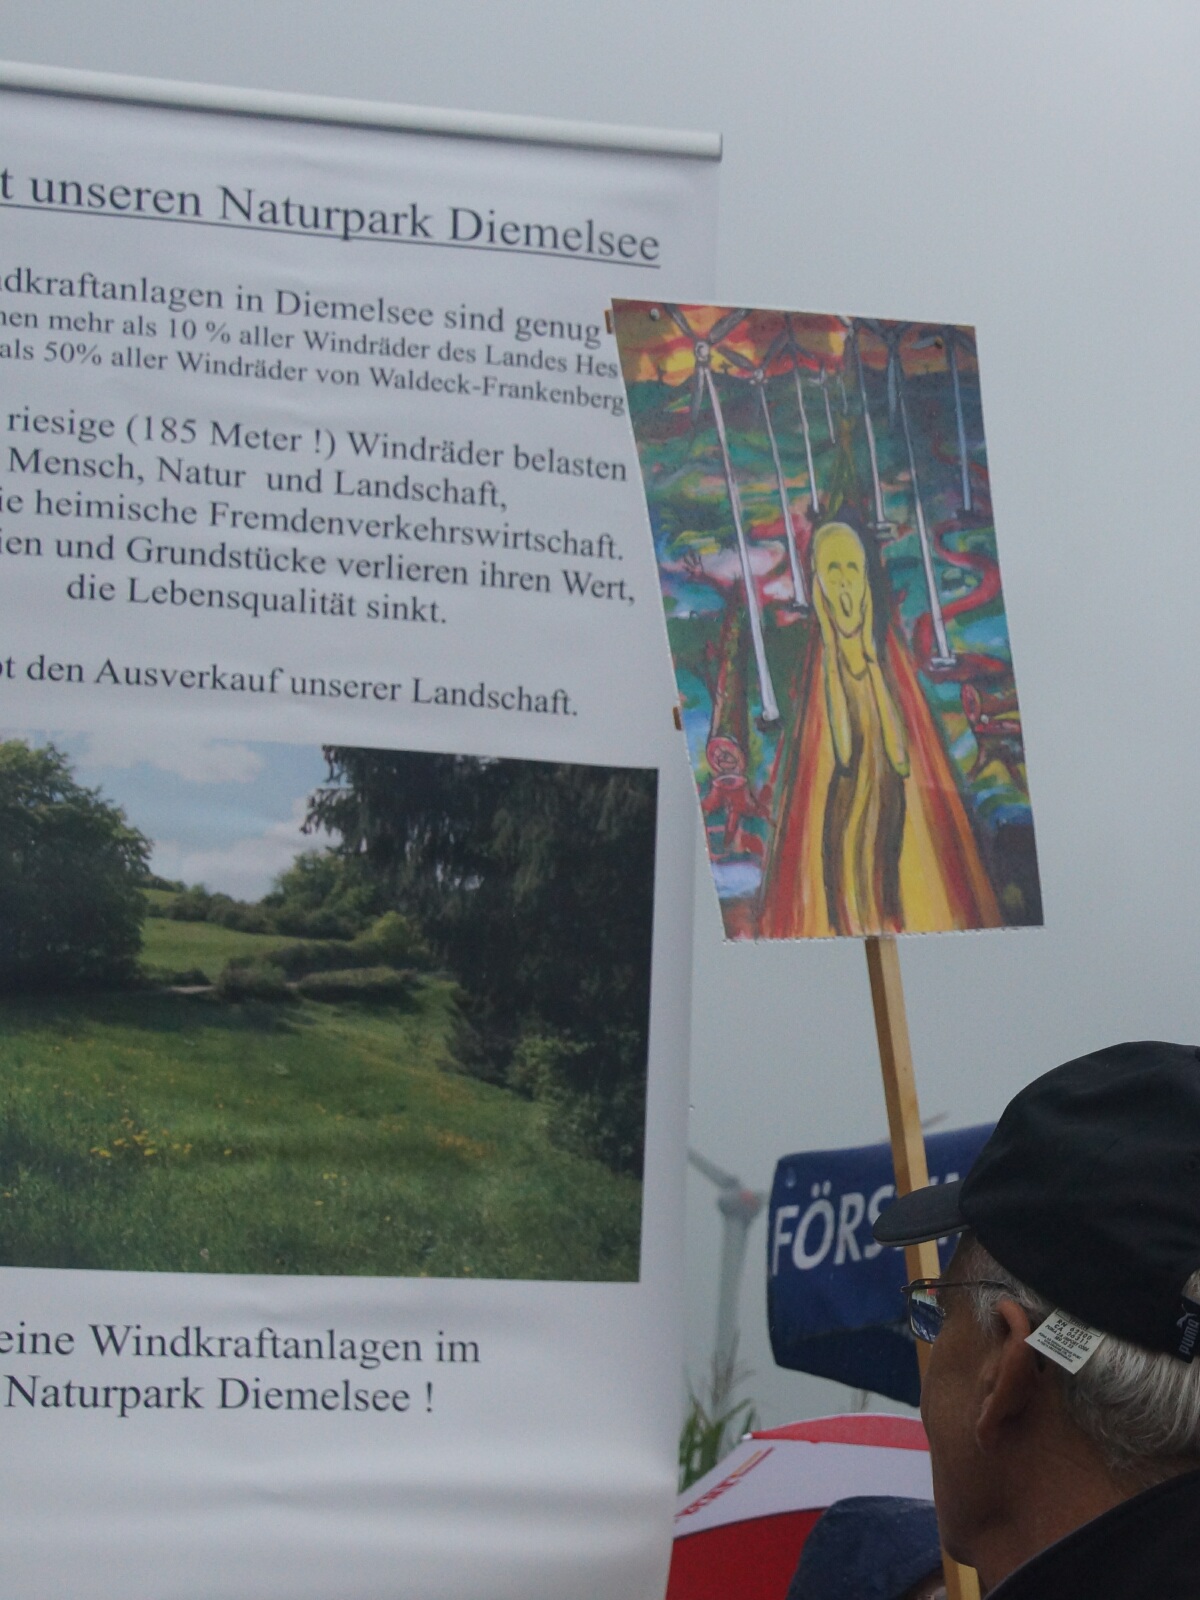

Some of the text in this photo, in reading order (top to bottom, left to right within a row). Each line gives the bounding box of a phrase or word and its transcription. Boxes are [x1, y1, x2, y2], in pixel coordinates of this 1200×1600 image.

[0, 168, 661, 263] t unseren Naturpark Diemelsee
[0, 267, 600, 349] dkraftanlagen in Diemelsee sind genug
[49, 311, 114, 334] mehr
[122, 315, 157, 337] als
[171, 318, 197, 340] 10
[206, 320, 231, 345] %
[239, 325, 295, 349] aller
[303, 330, 430, 359] Windräder
[437, 341, 476, 363] des
[486, 344, 567, 372] Landes
[0, 338, 623, 416] als 50% aller Windräder von Waldeck-Frankenberg
[8, 406, 626, 482] riesige (185 Meter !) Windräder belasten
[9, 446, 507, 512] Mensch, Natur und Landschaft,
[35, 489, 197, 525] heimische
[210, 501, 623, 560] Fremdenverkehrswirtschaft.
[55, 534, 114, 560] und
[126, 536, 326, 575] Grundstücke
[337, 553, 468, 585] verlieren
[480, 562, 550, 593] ihren
[562, 569, 635, 605] Wert,
[66, 573, 446, 624] die Lebensqualität sinkt.
[0, 654, 577, 716] t den Ausverkauf unserer Landschaft.
[88, 1324, 422, 1370] Windkraftanlagen
[436, 1330, 480, 1363] im
[1178, 1318, 1200, 1355] PUMA
[3, 1375, 434, 1418] Naturpark Diemelsee !
